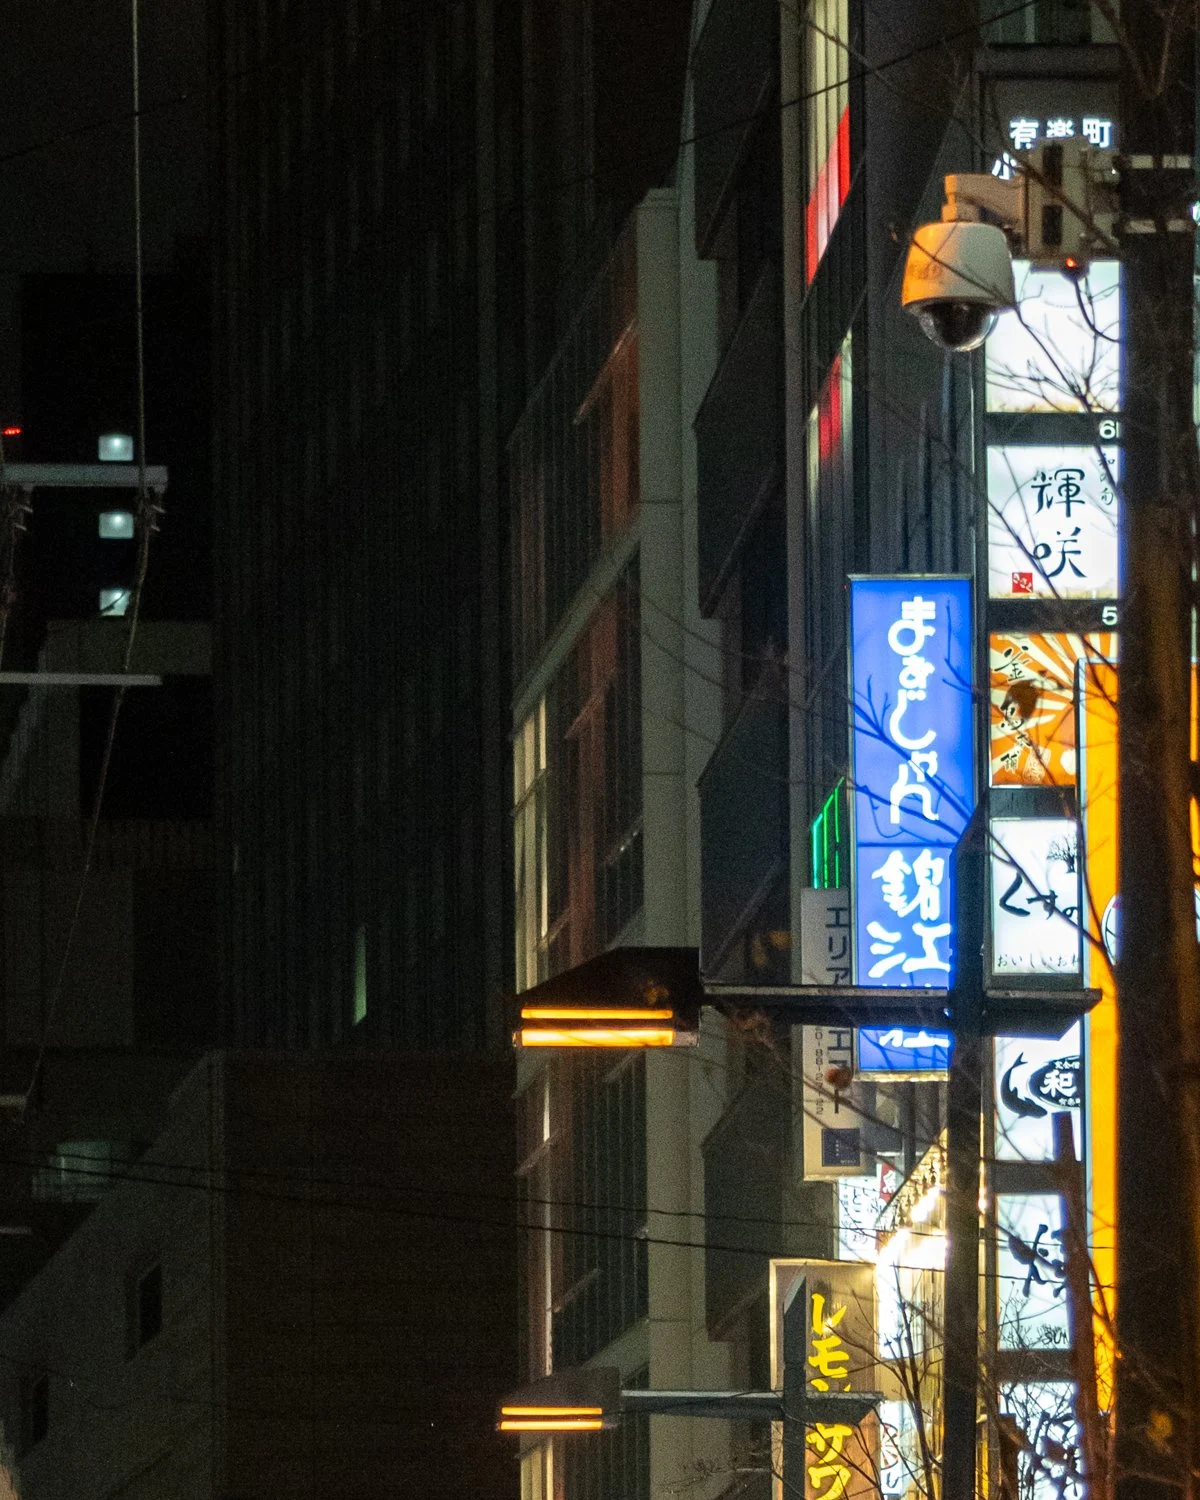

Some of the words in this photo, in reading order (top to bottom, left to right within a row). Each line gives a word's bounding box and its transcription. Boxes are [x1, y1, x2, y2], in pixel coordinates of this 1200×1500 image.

[1009, 117, 1113, 150] 有楽町
[1099, 420, 1120, 439] 6
[1031, 468, 1087, 578] 輝咲
[1102, 606, 1117, 625] 5
[888, 596, 939, 824] まぁじゃん
[866, 849, 951, 1048] 錦江
